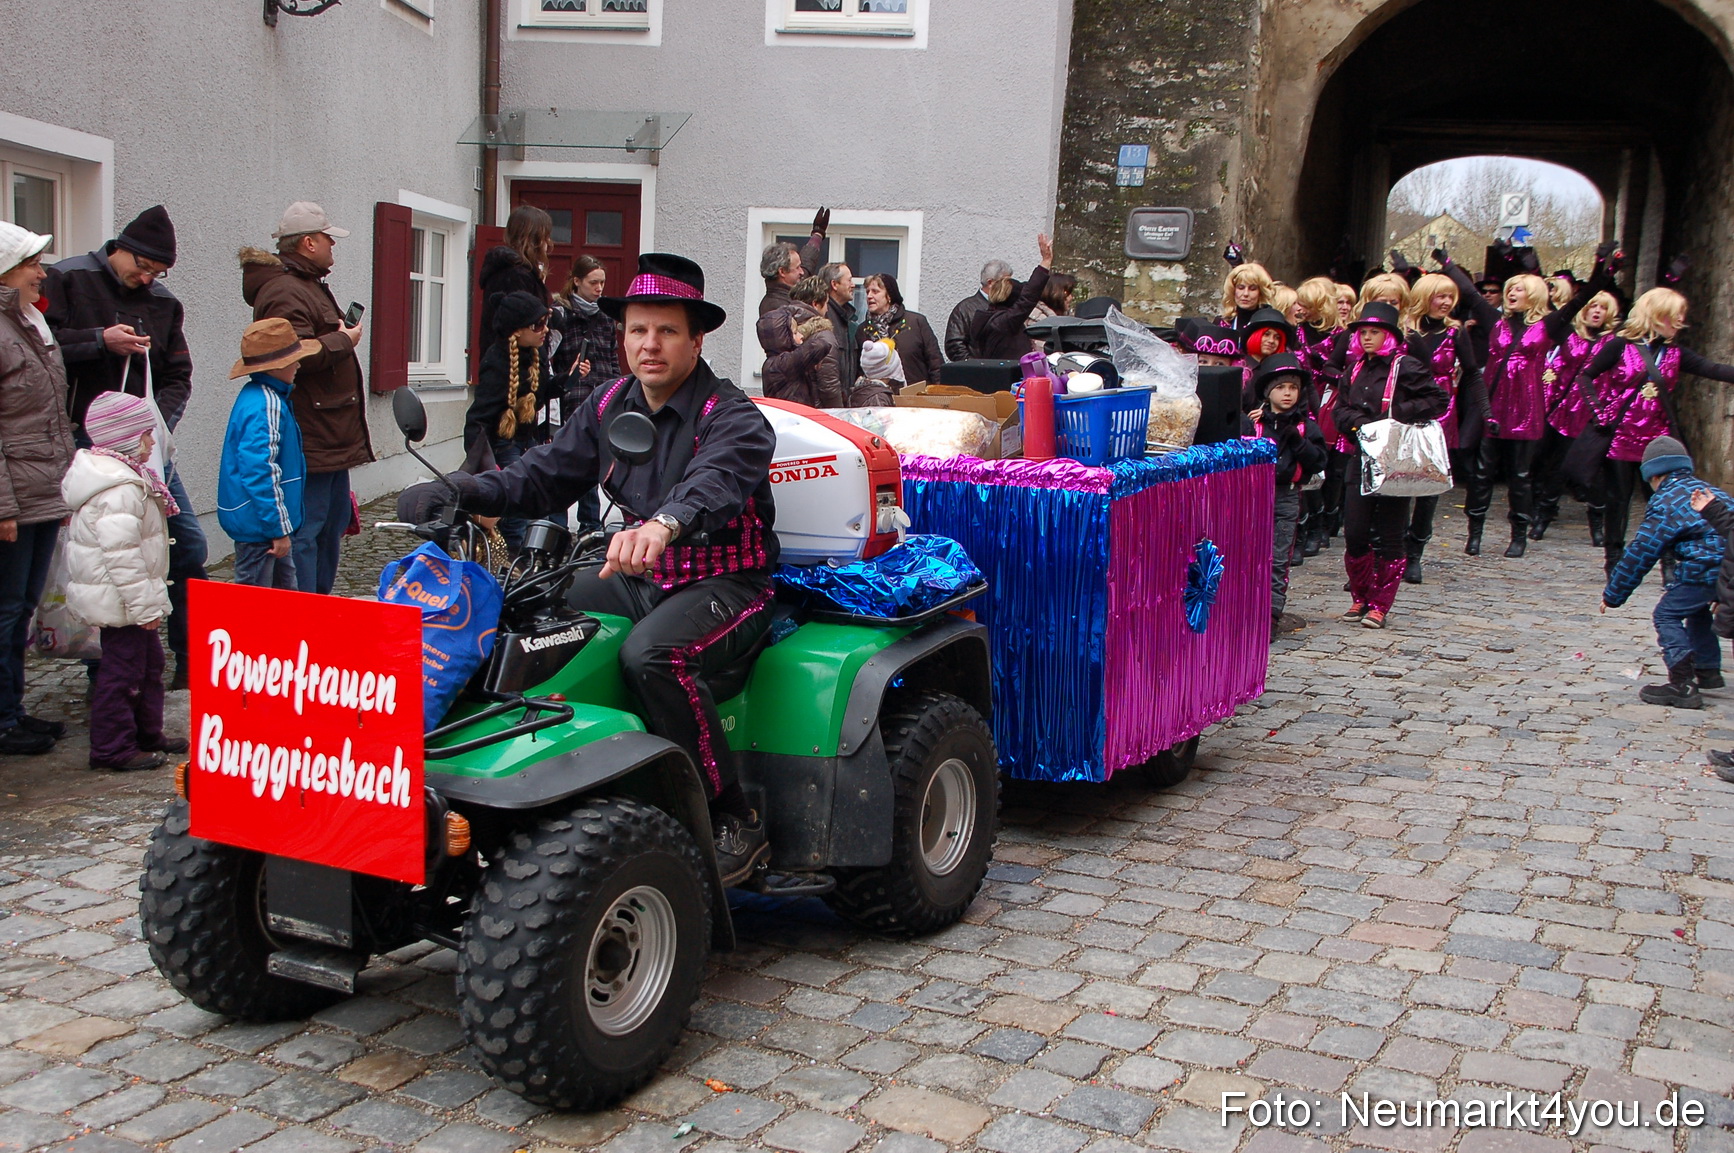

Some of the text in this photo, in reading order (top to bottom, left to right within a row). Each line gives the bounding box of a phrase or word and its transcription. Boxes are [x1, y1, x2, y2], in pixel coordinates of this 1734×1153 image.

[769, 465, 839, 484] ONDA
[520, 626, 585, 653] Kawasaki
[208, 628, 397, 715] Powerfrauen
[199, 713, 411, 808] Burggriesbach
